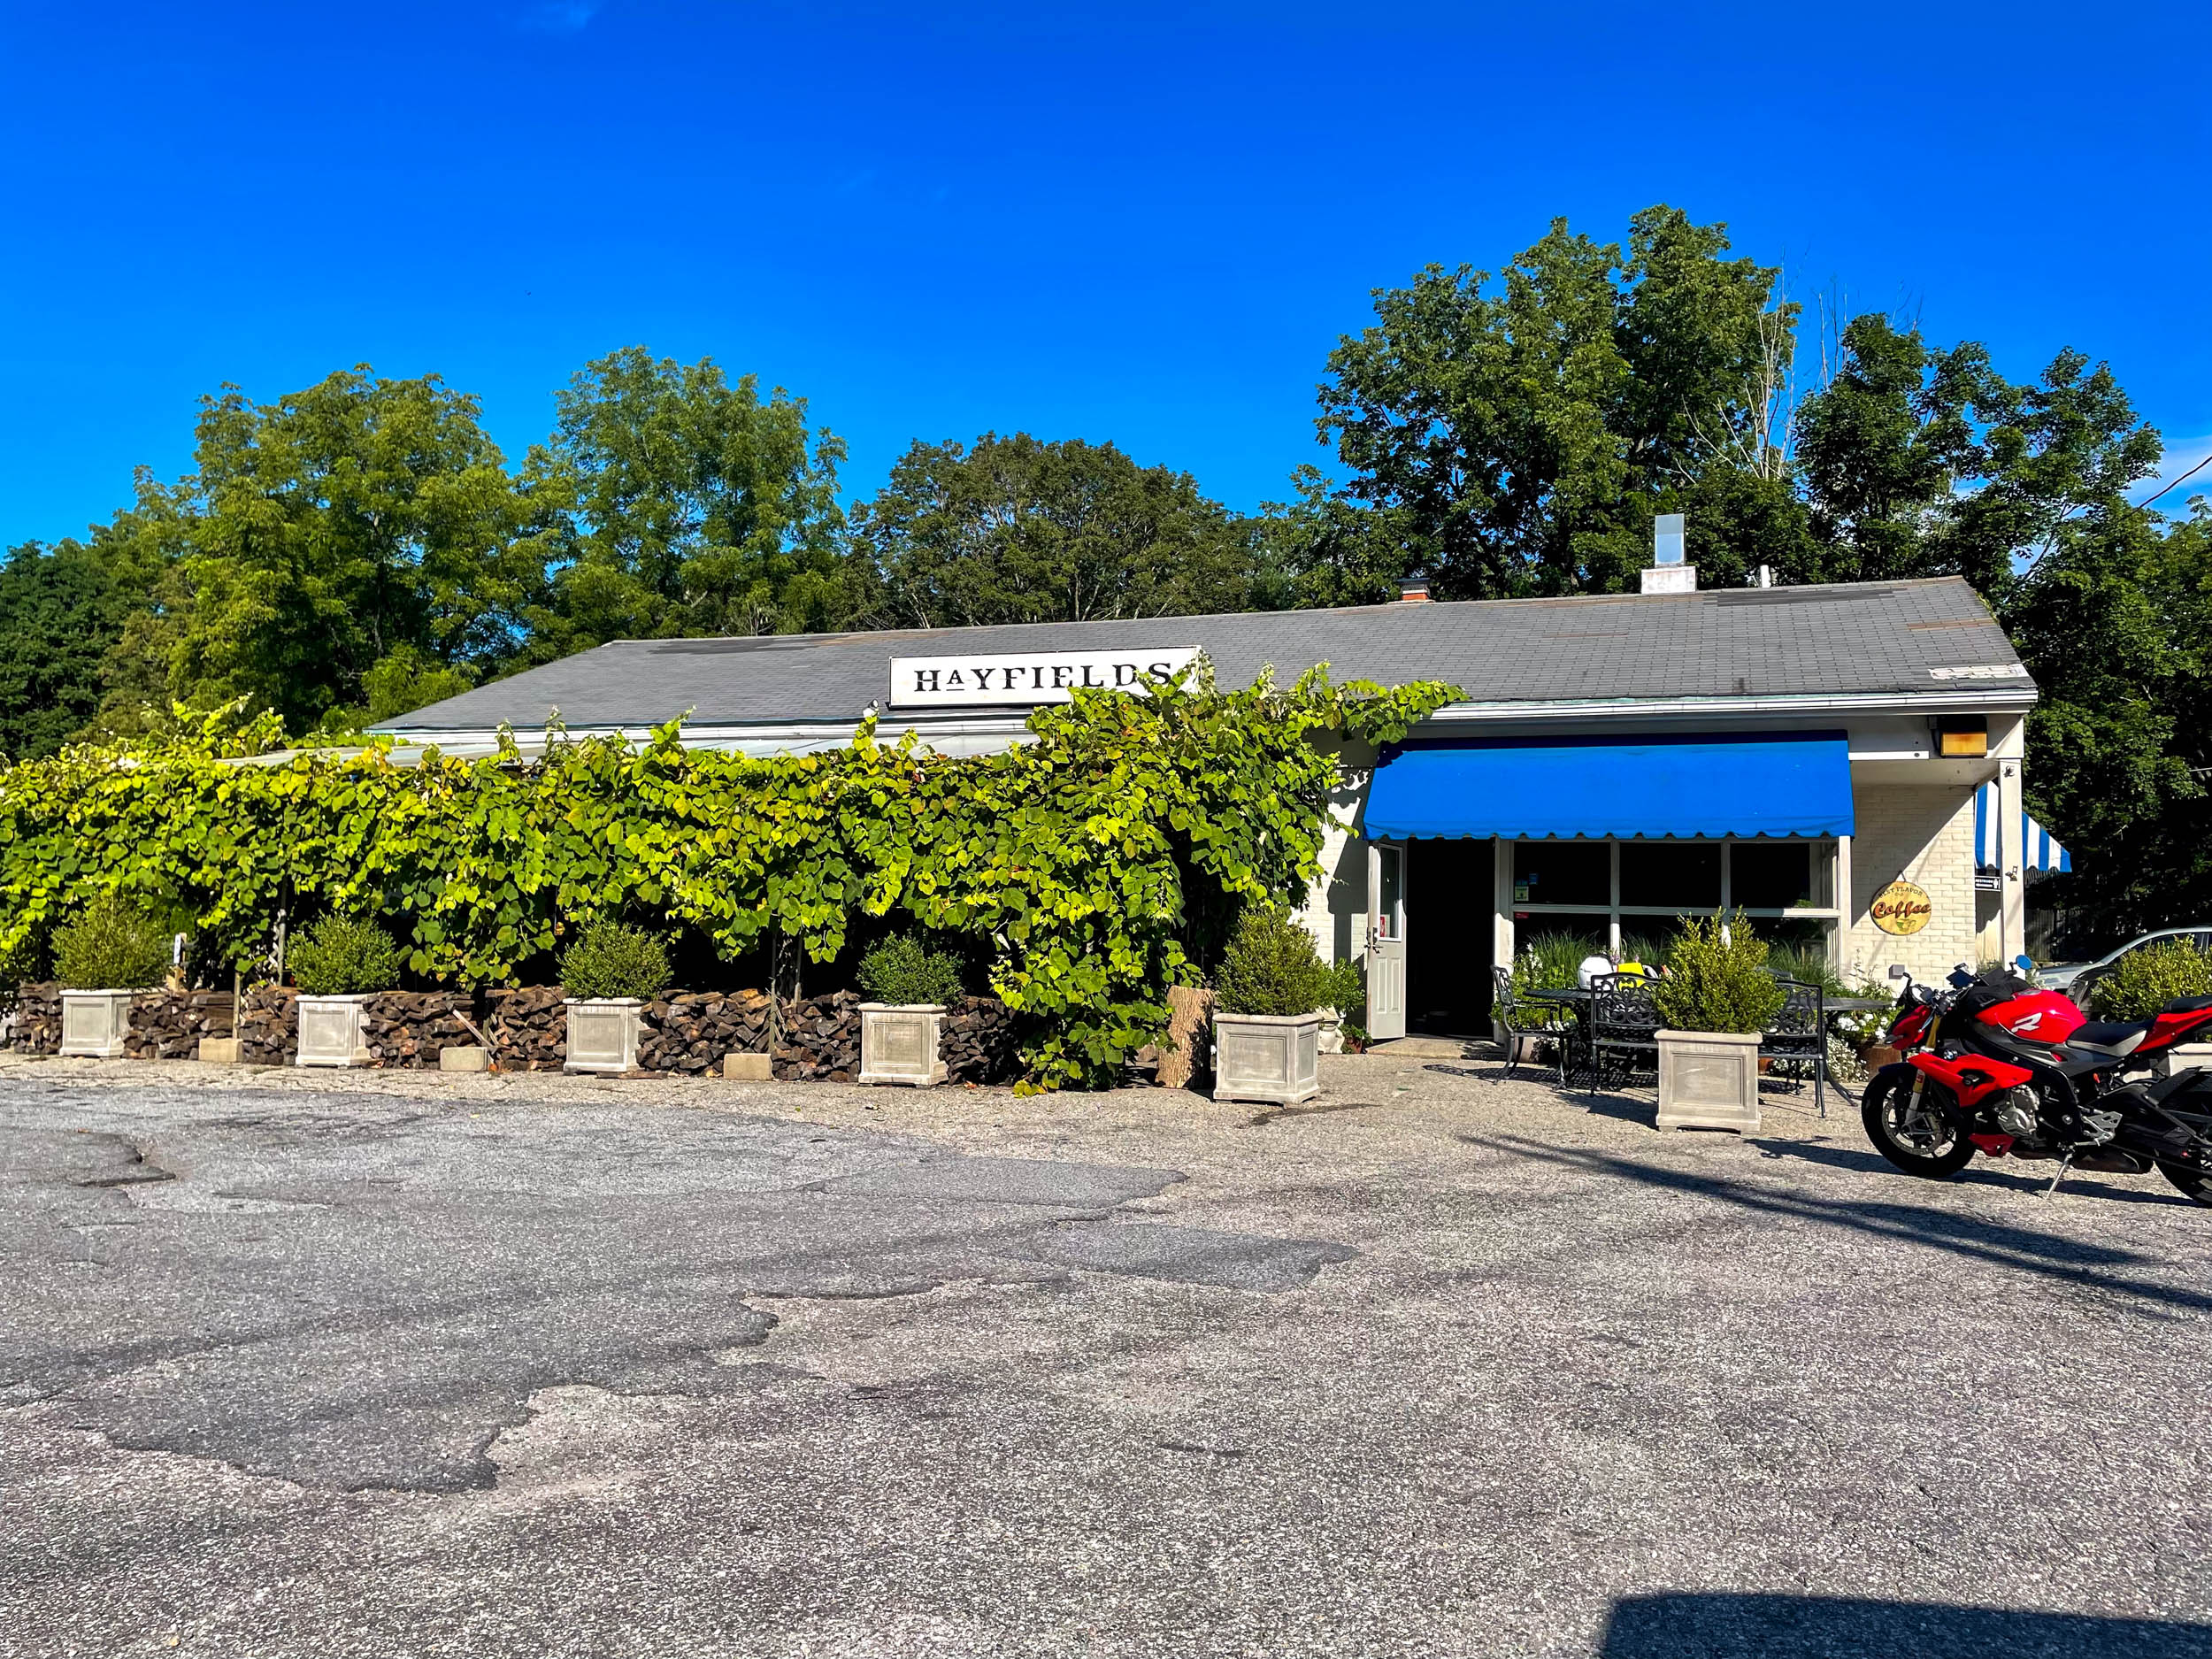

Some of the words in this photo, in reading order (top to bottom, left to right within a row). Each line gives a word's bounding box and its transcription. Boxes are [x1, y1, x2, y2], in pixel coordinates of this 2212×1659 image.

[914, 663, 1171, 692] HAYFIELDS
[1896, 887, 1923, 897] FLAVOR
[1872, 901, 1932, 919] Coffee
